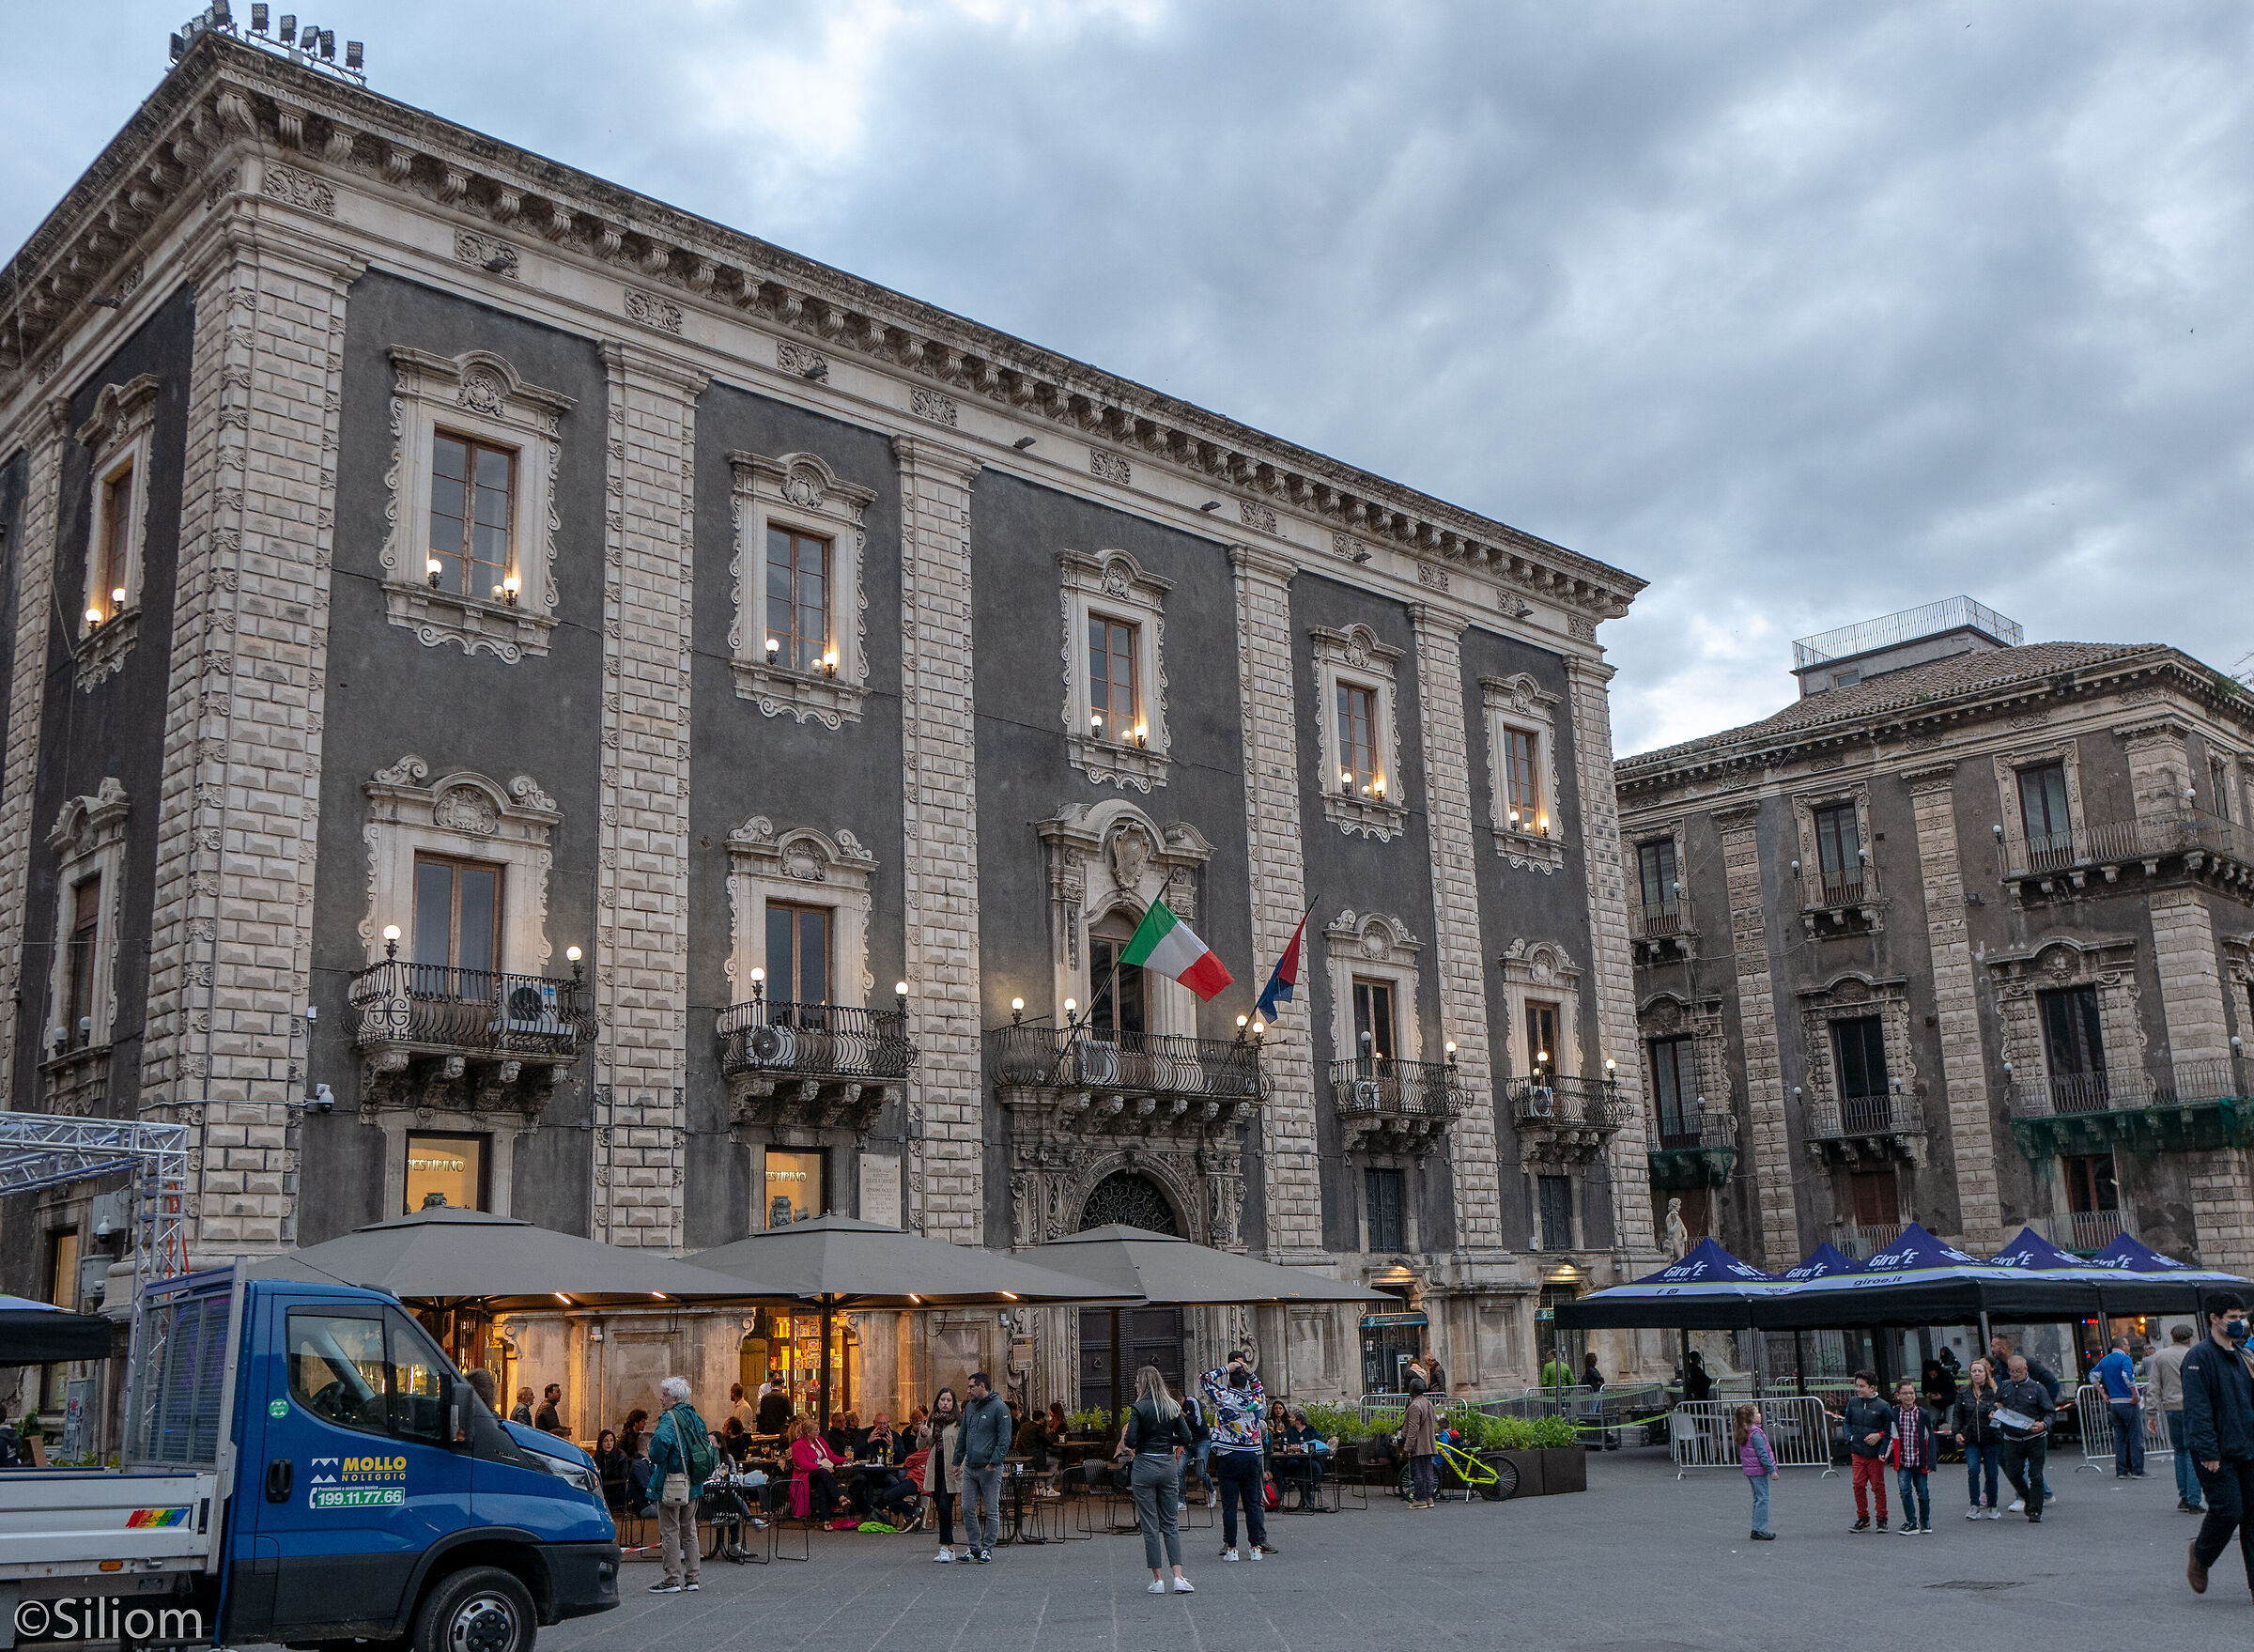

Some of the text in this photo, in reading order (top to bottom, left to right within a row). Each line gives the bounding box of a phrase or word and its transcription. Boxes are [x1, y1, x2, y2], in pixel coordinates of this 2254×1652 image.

[1854, 1275, 1903, 1287] giroe.it
[343, 1456, 407, 1472] MOLLO
[342, 1473, 407, 1482] NOLEGGIO
[317, 1490, 402, 1505] 199.11.77.66
